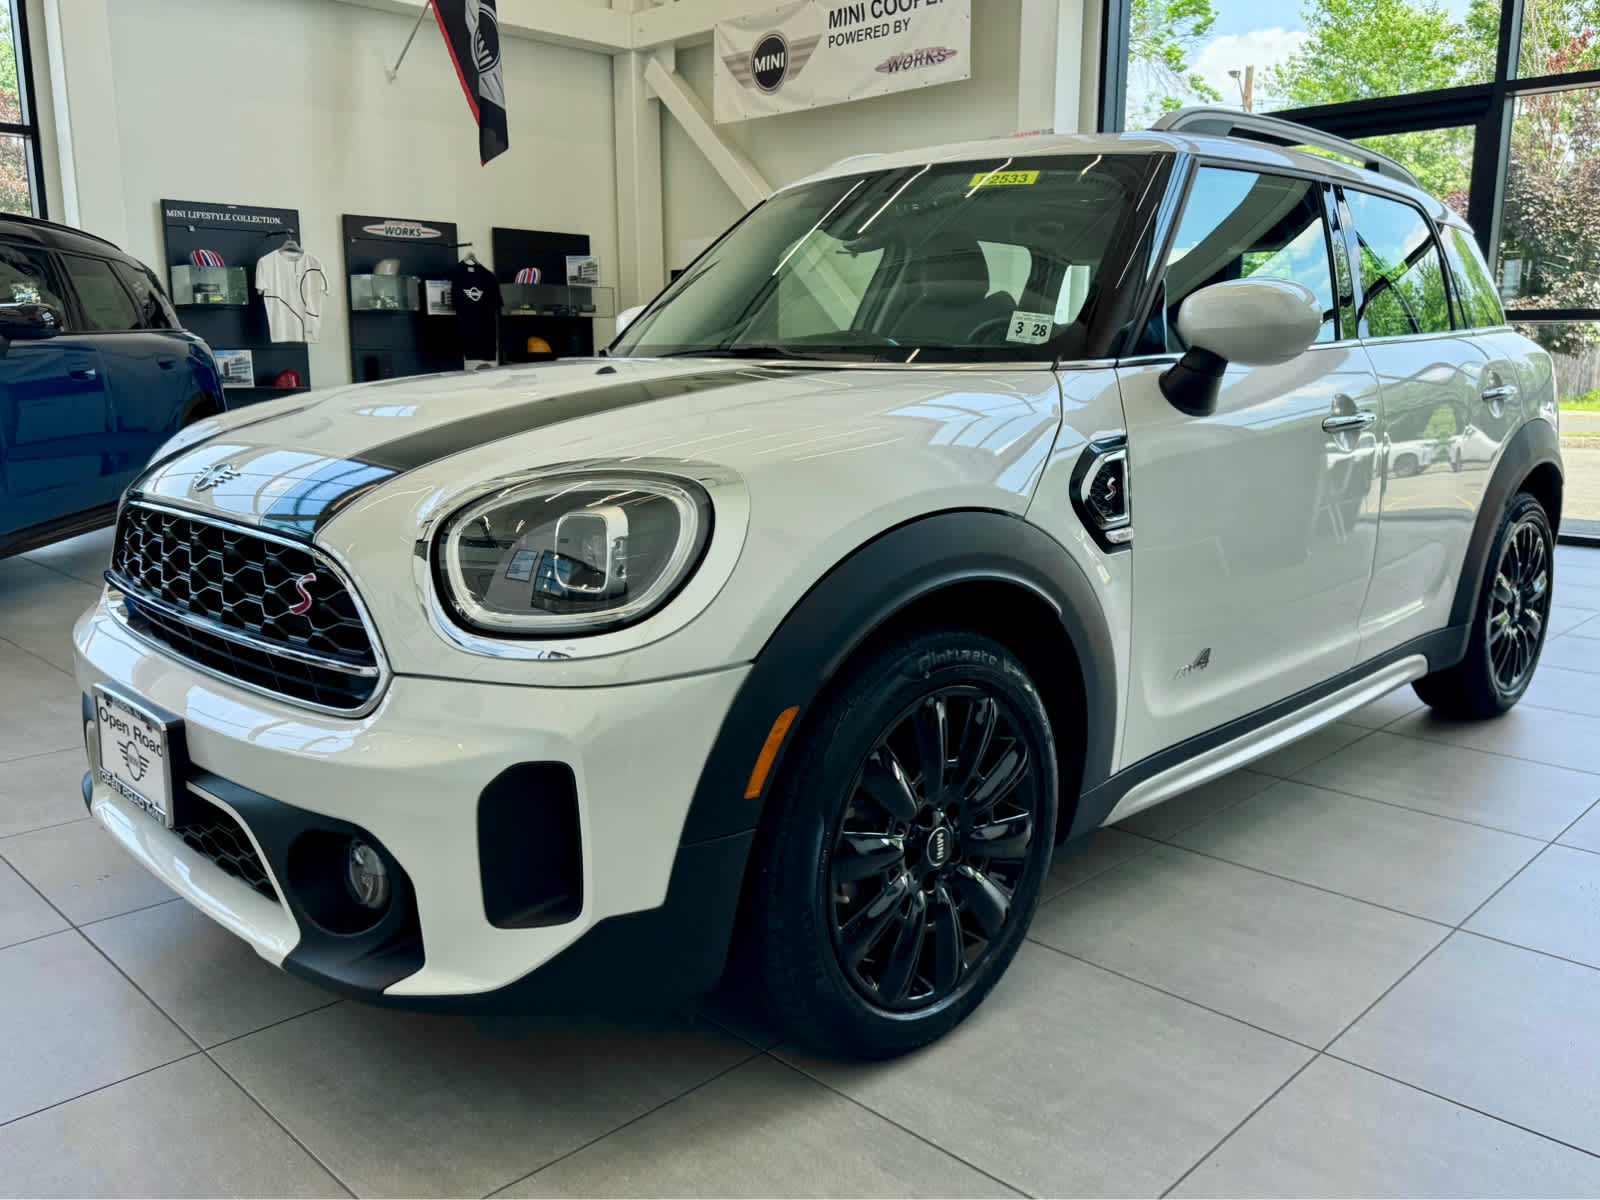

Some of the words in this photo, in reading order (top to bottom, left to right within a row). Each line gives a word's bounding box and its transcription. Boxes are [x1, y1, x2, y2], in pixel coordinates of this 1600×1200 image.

[828, 2, 866, 30] MINI
[828, 23, 890, 48] POWERED
[893, 17, 911, 34] BY
[754, 51, 785, 73] MINI
[887, 51, 947, 74] WORKS
[166, 209, 187, 218] MINI
[188, 211, 232, 221] LIFESTYLE
[384, 226, 422, 237] WORKS
[1015, 321, 1024, 335] 3
[1031, 323, 1048, 337] 28
[290, 572, 316, 615] S
[99, 706, 130, 738] Open
[936, 832, 944, 860] MINI
